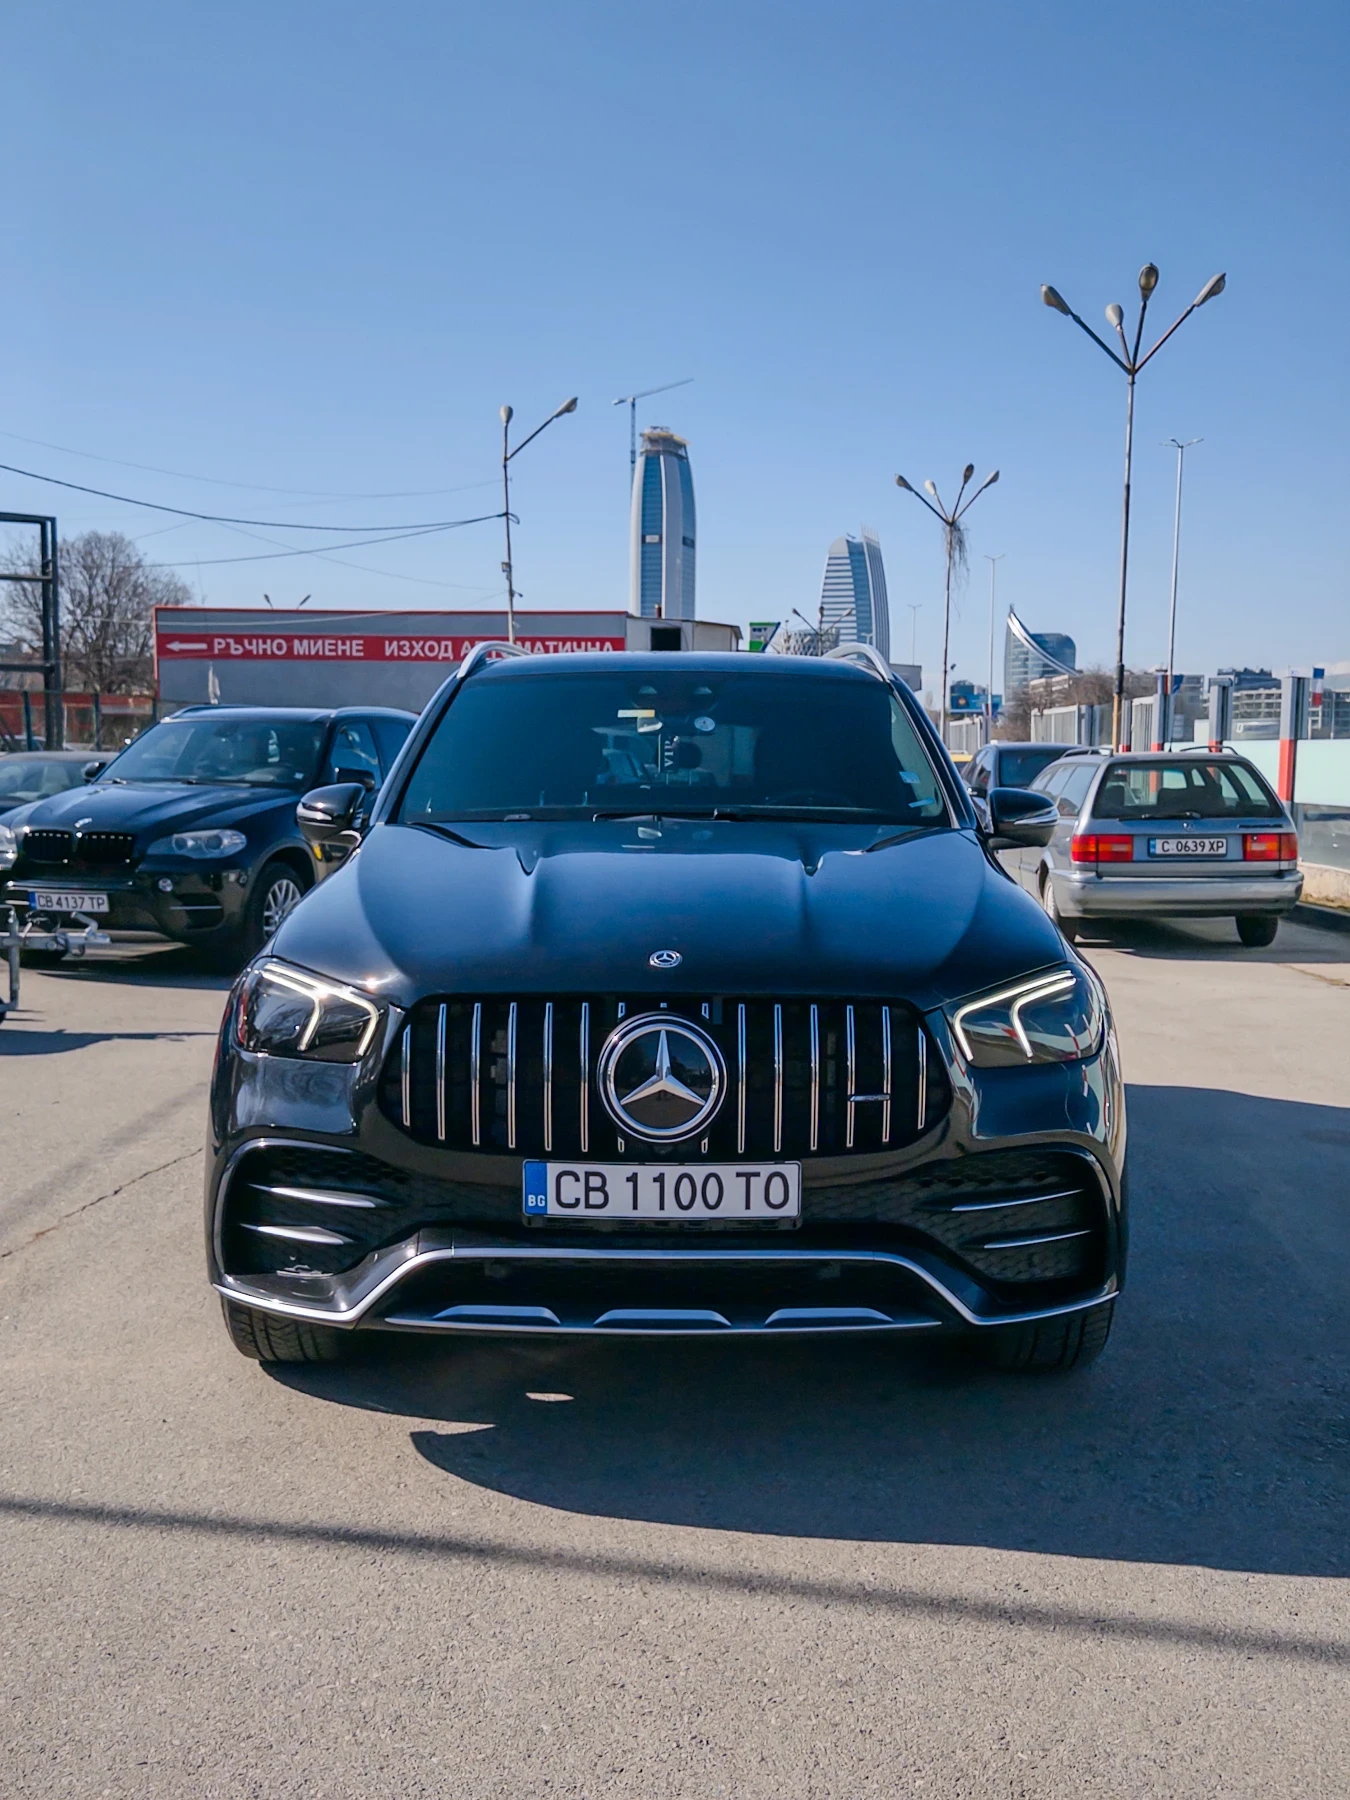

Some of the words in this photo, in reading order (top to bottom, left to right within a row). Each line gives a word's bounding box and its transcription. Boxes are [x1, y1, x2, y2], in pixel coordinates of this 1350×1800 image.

[213, 638, 287, 655] РЪЧНО
[293, 639, 364, 656] МИЕНЕ
[385, 640, 453, 660] ИЗХОД
[1161, 840, 1170, 853] C
[1176, 840, 1206, 852] 0639
[1208, 840, 1224, 852] XP
[37, 894, 54, 908] CB
[56, 896, 86, 910] 4137
[89, 897, 106, 910] TP
[555, 1170, 610, 1210] CB
[625, 1172, 725, 1212] 1100
[527, 1194, 546, 1207] BG
